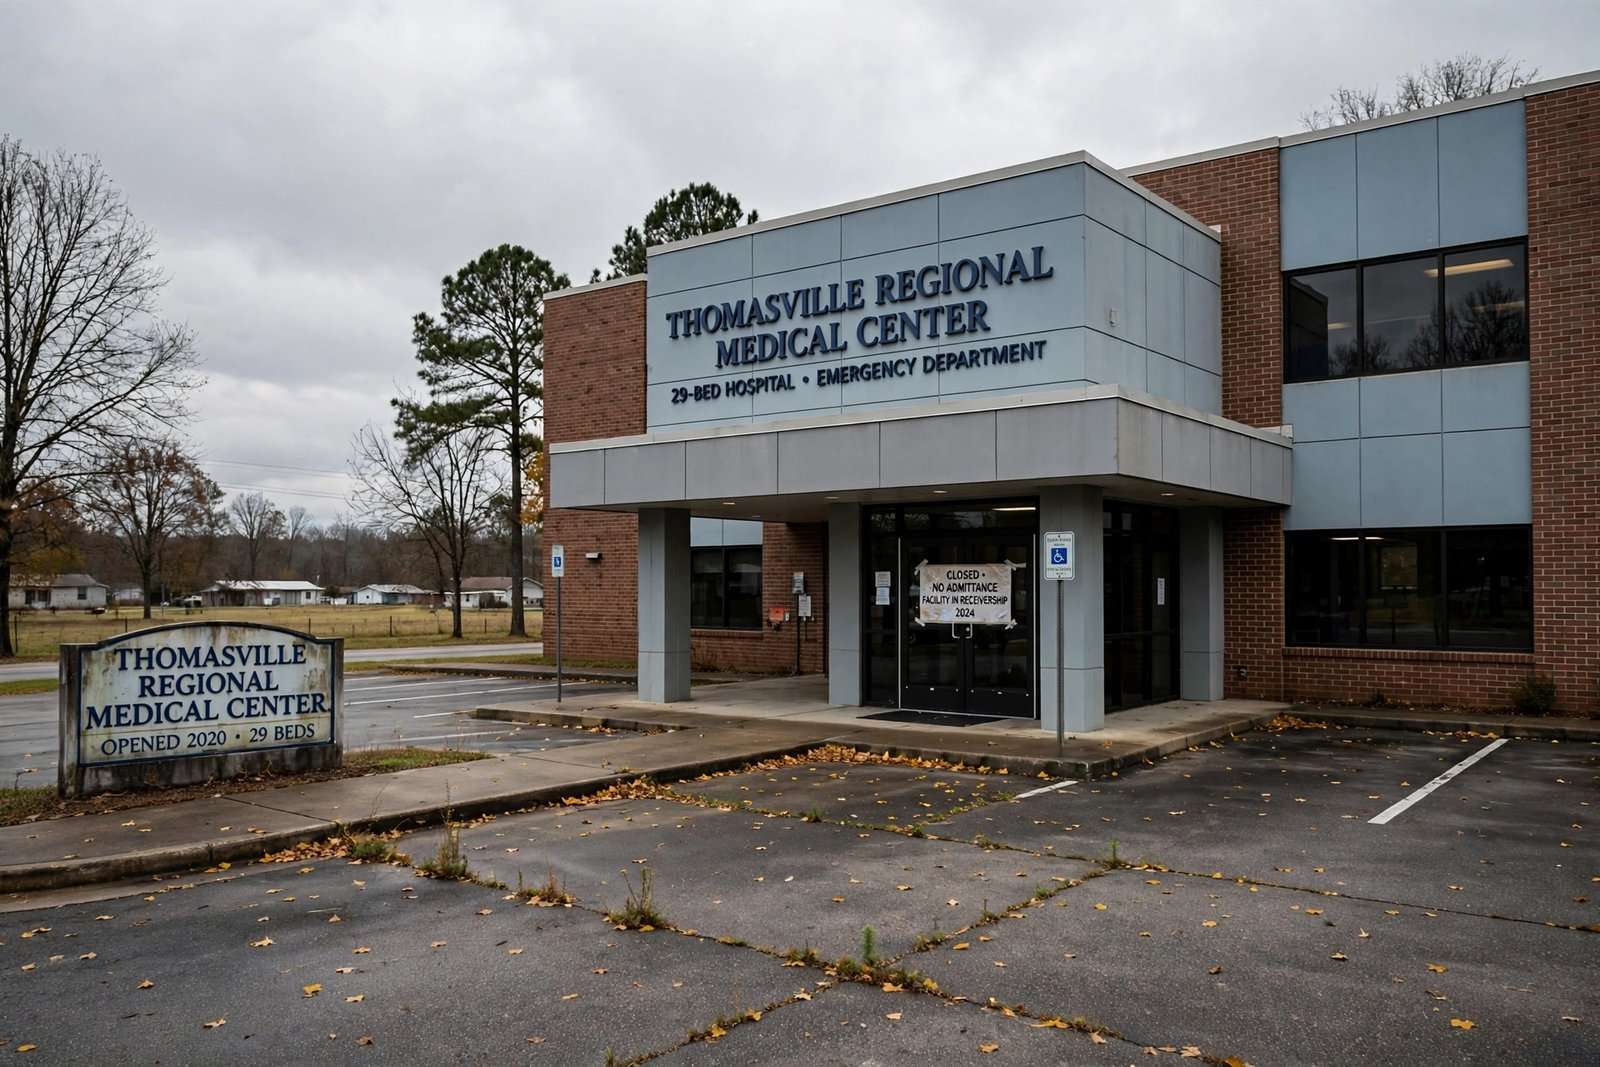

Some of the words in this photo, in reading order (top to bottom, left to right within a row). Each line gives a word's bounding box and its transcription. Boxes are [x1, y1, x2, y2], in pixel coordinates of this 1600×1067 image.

[666, 278, 864, 340] THOMASVILLE
[875, 245, 1054, 306] REGIONAL
[715, 322, 847, 369] MEDICAL
[856, 299, 991, 348] CENTER
[671, 382, 721, 404] 29-BED
[725, 373, 796, 399] HOSPITAL
[816, 357, 918, 387] EMERGENCY
[922, 340, 1047, 374] DEPARTMENT
[932, 582, 945, 592] NO
[946, 582, 998, 592] ADMITTANCE
[946, 570, 980, 580] CLOSED
[922, 595, 950, 605] FACILITY
[951, 595, 959, 605] IN
[955, 608, 975, 617] 2024
[114, 643, 307, 672] THOMASVILLE
[138, 670, 279, 698] REGIONAL
[85, 700, 219, 730] MEDICAL
[227, 692, 331, 719] CENTER
[101, 734, 180, 756] OPENED
[187, 730, 227, 748] 2020
[249, 726, 268, 744] 29
[274, 723, 315, 741] BEDS
